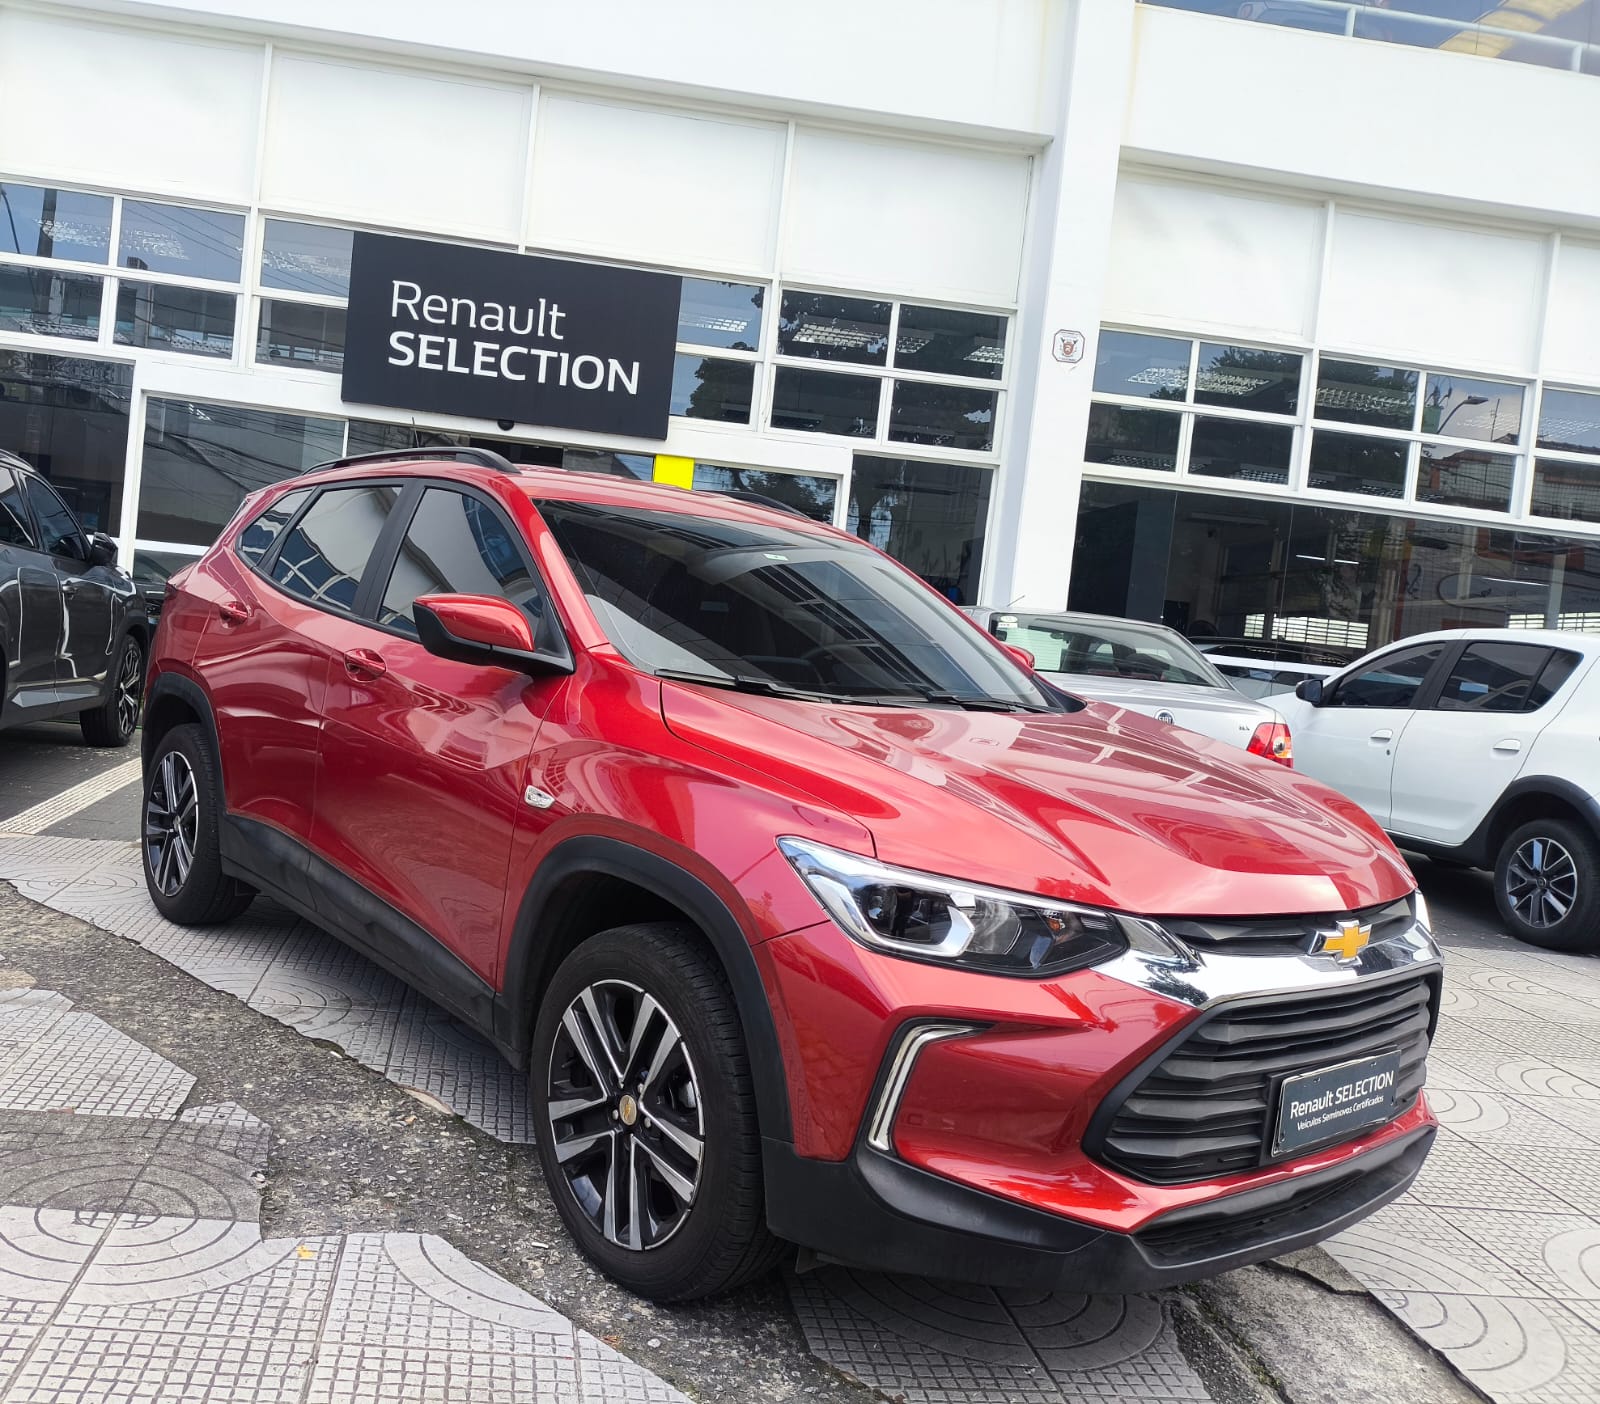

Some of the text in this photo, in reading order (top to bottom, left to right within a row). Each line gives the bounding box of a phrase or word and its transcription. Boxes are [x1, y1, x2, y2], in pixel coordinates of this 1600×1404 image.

[391, 280, 566, 340] Renault
[388, 330, 640, 395] SELECTION
[1290, 1070, 1394, 1119] Renault SELECTION
[1322, 1105, 1352, 1123] Seminovos
[1352, 1095, 1384, 1114] Certificados
